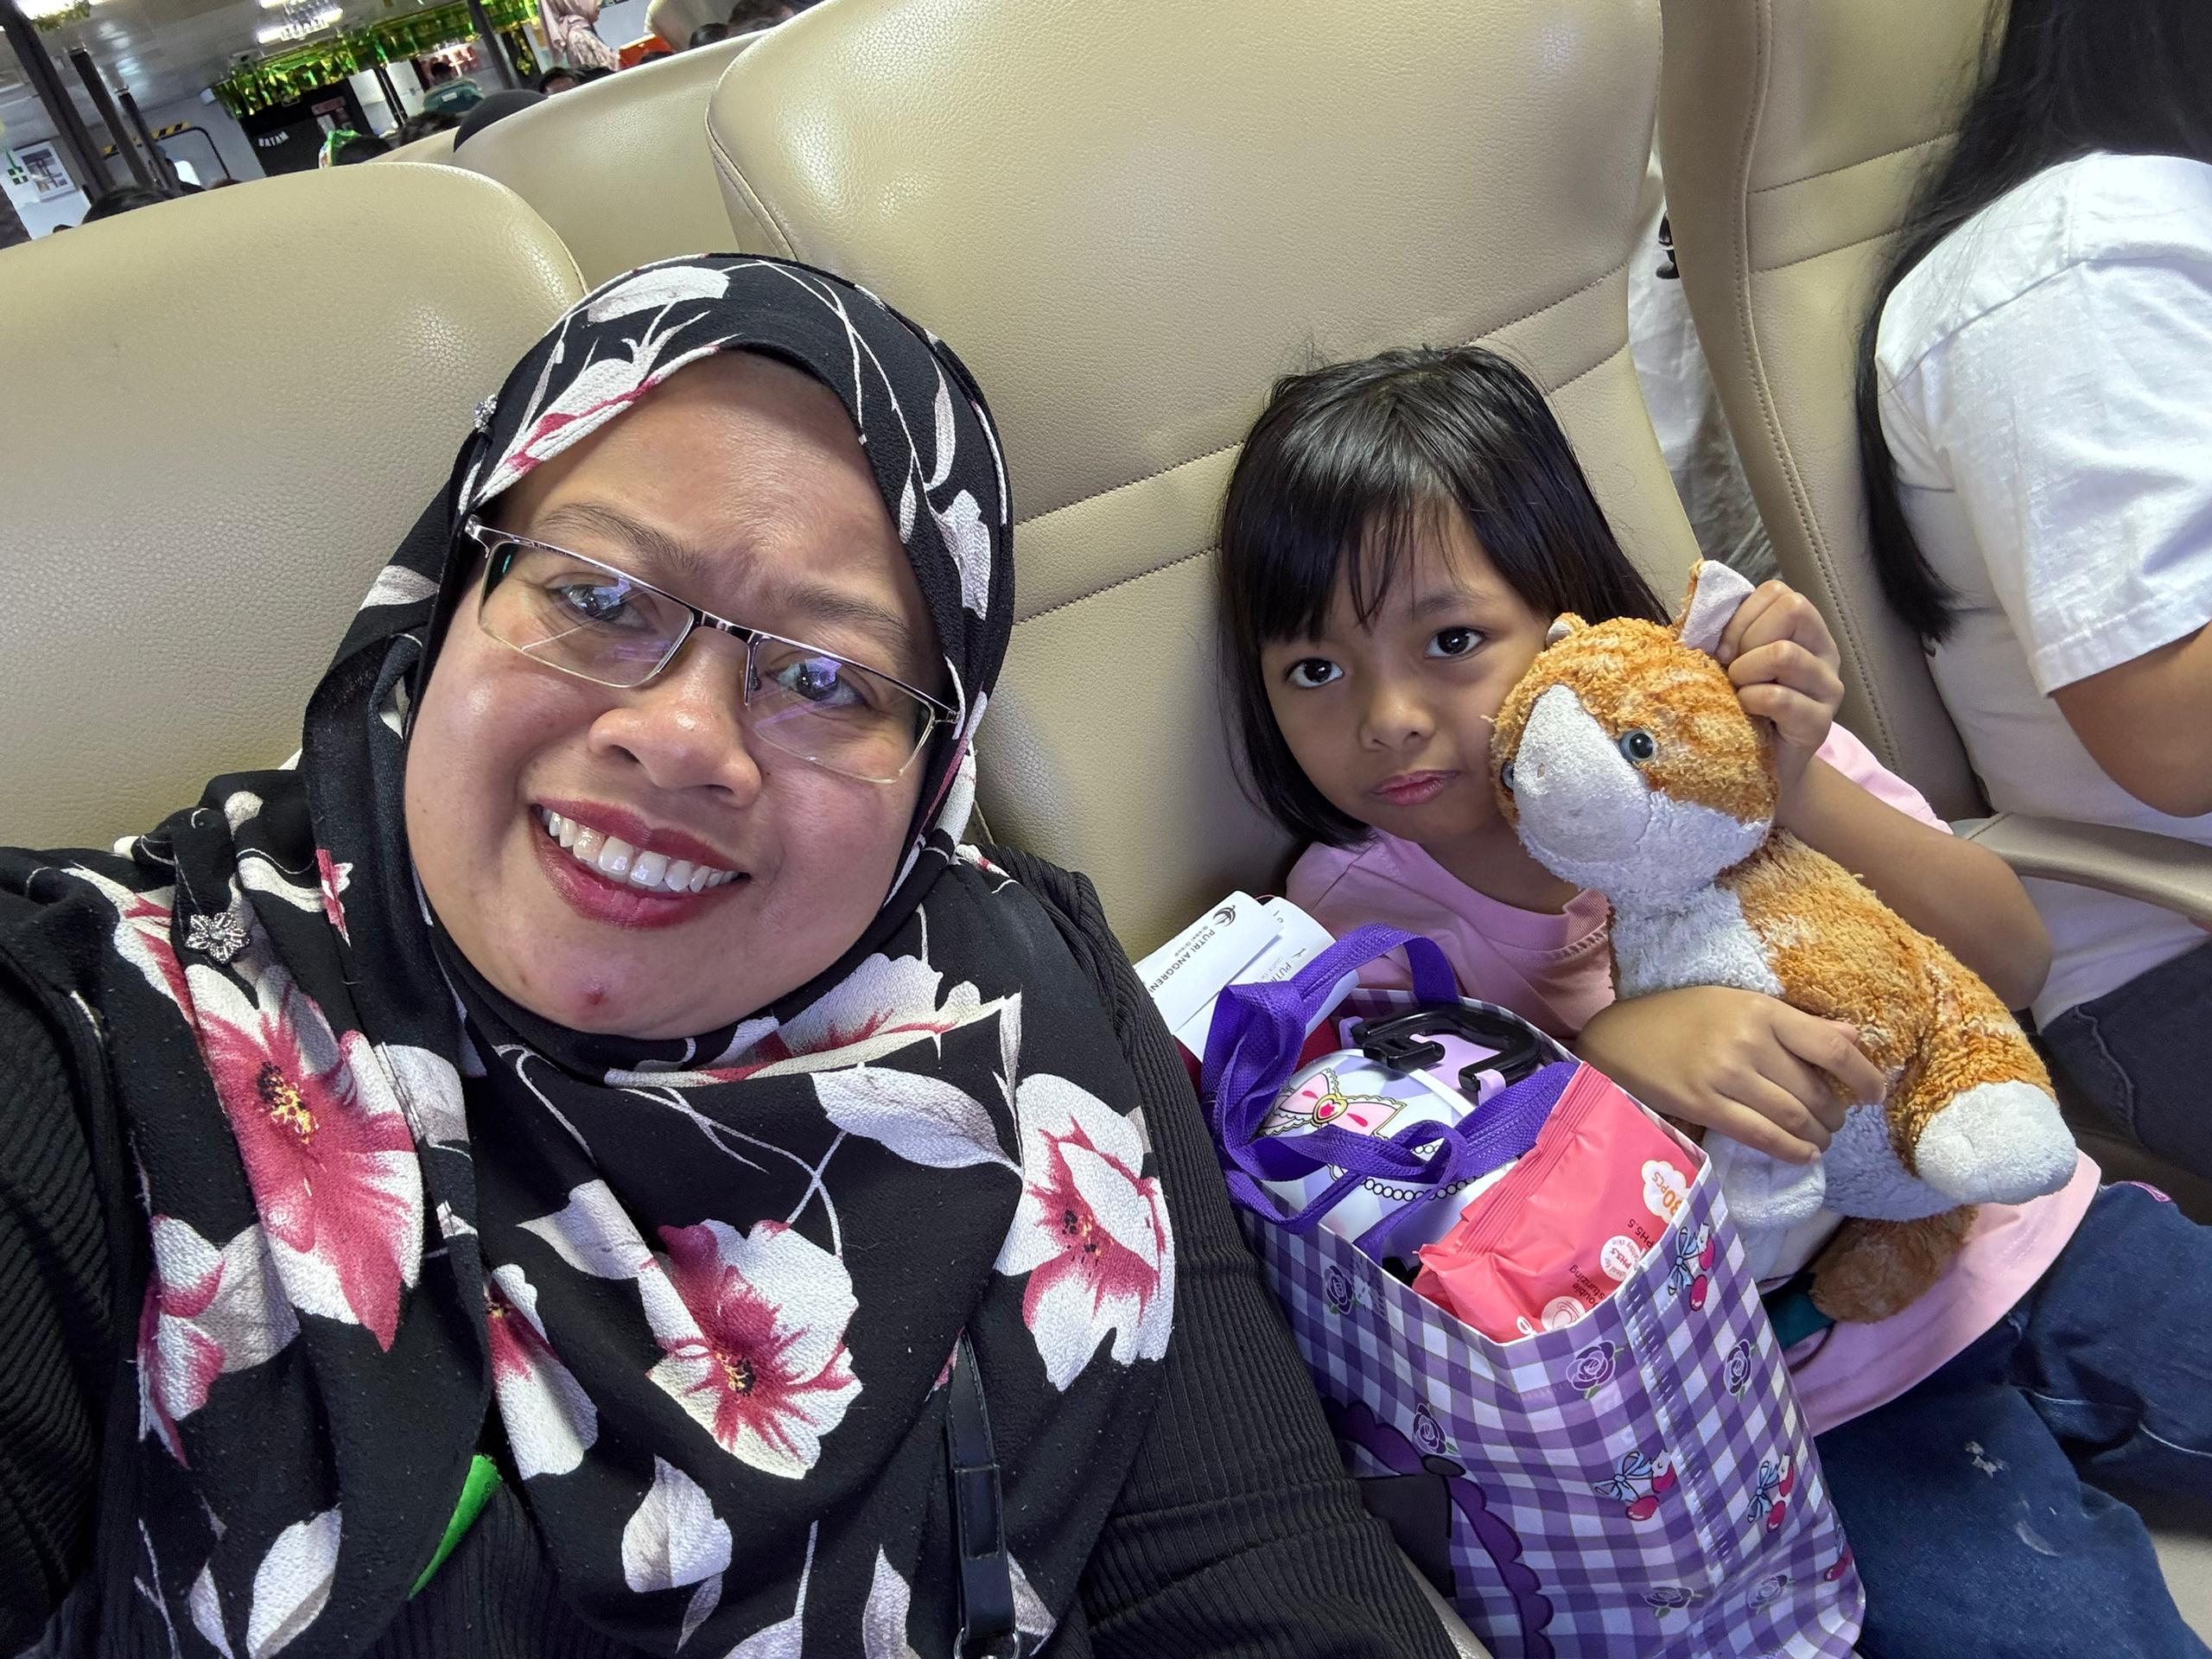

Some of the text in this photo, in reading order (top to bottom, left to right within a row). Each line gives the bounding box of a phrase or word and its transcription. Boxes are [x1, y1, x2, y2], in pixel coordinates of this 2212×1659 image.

[1147, 929, 1216, 993] PUTRI ANGGRENI
[1627, 1218, 1656, 1249] PH5.5
[1569, 1264, 1605, 1300] sturizing
